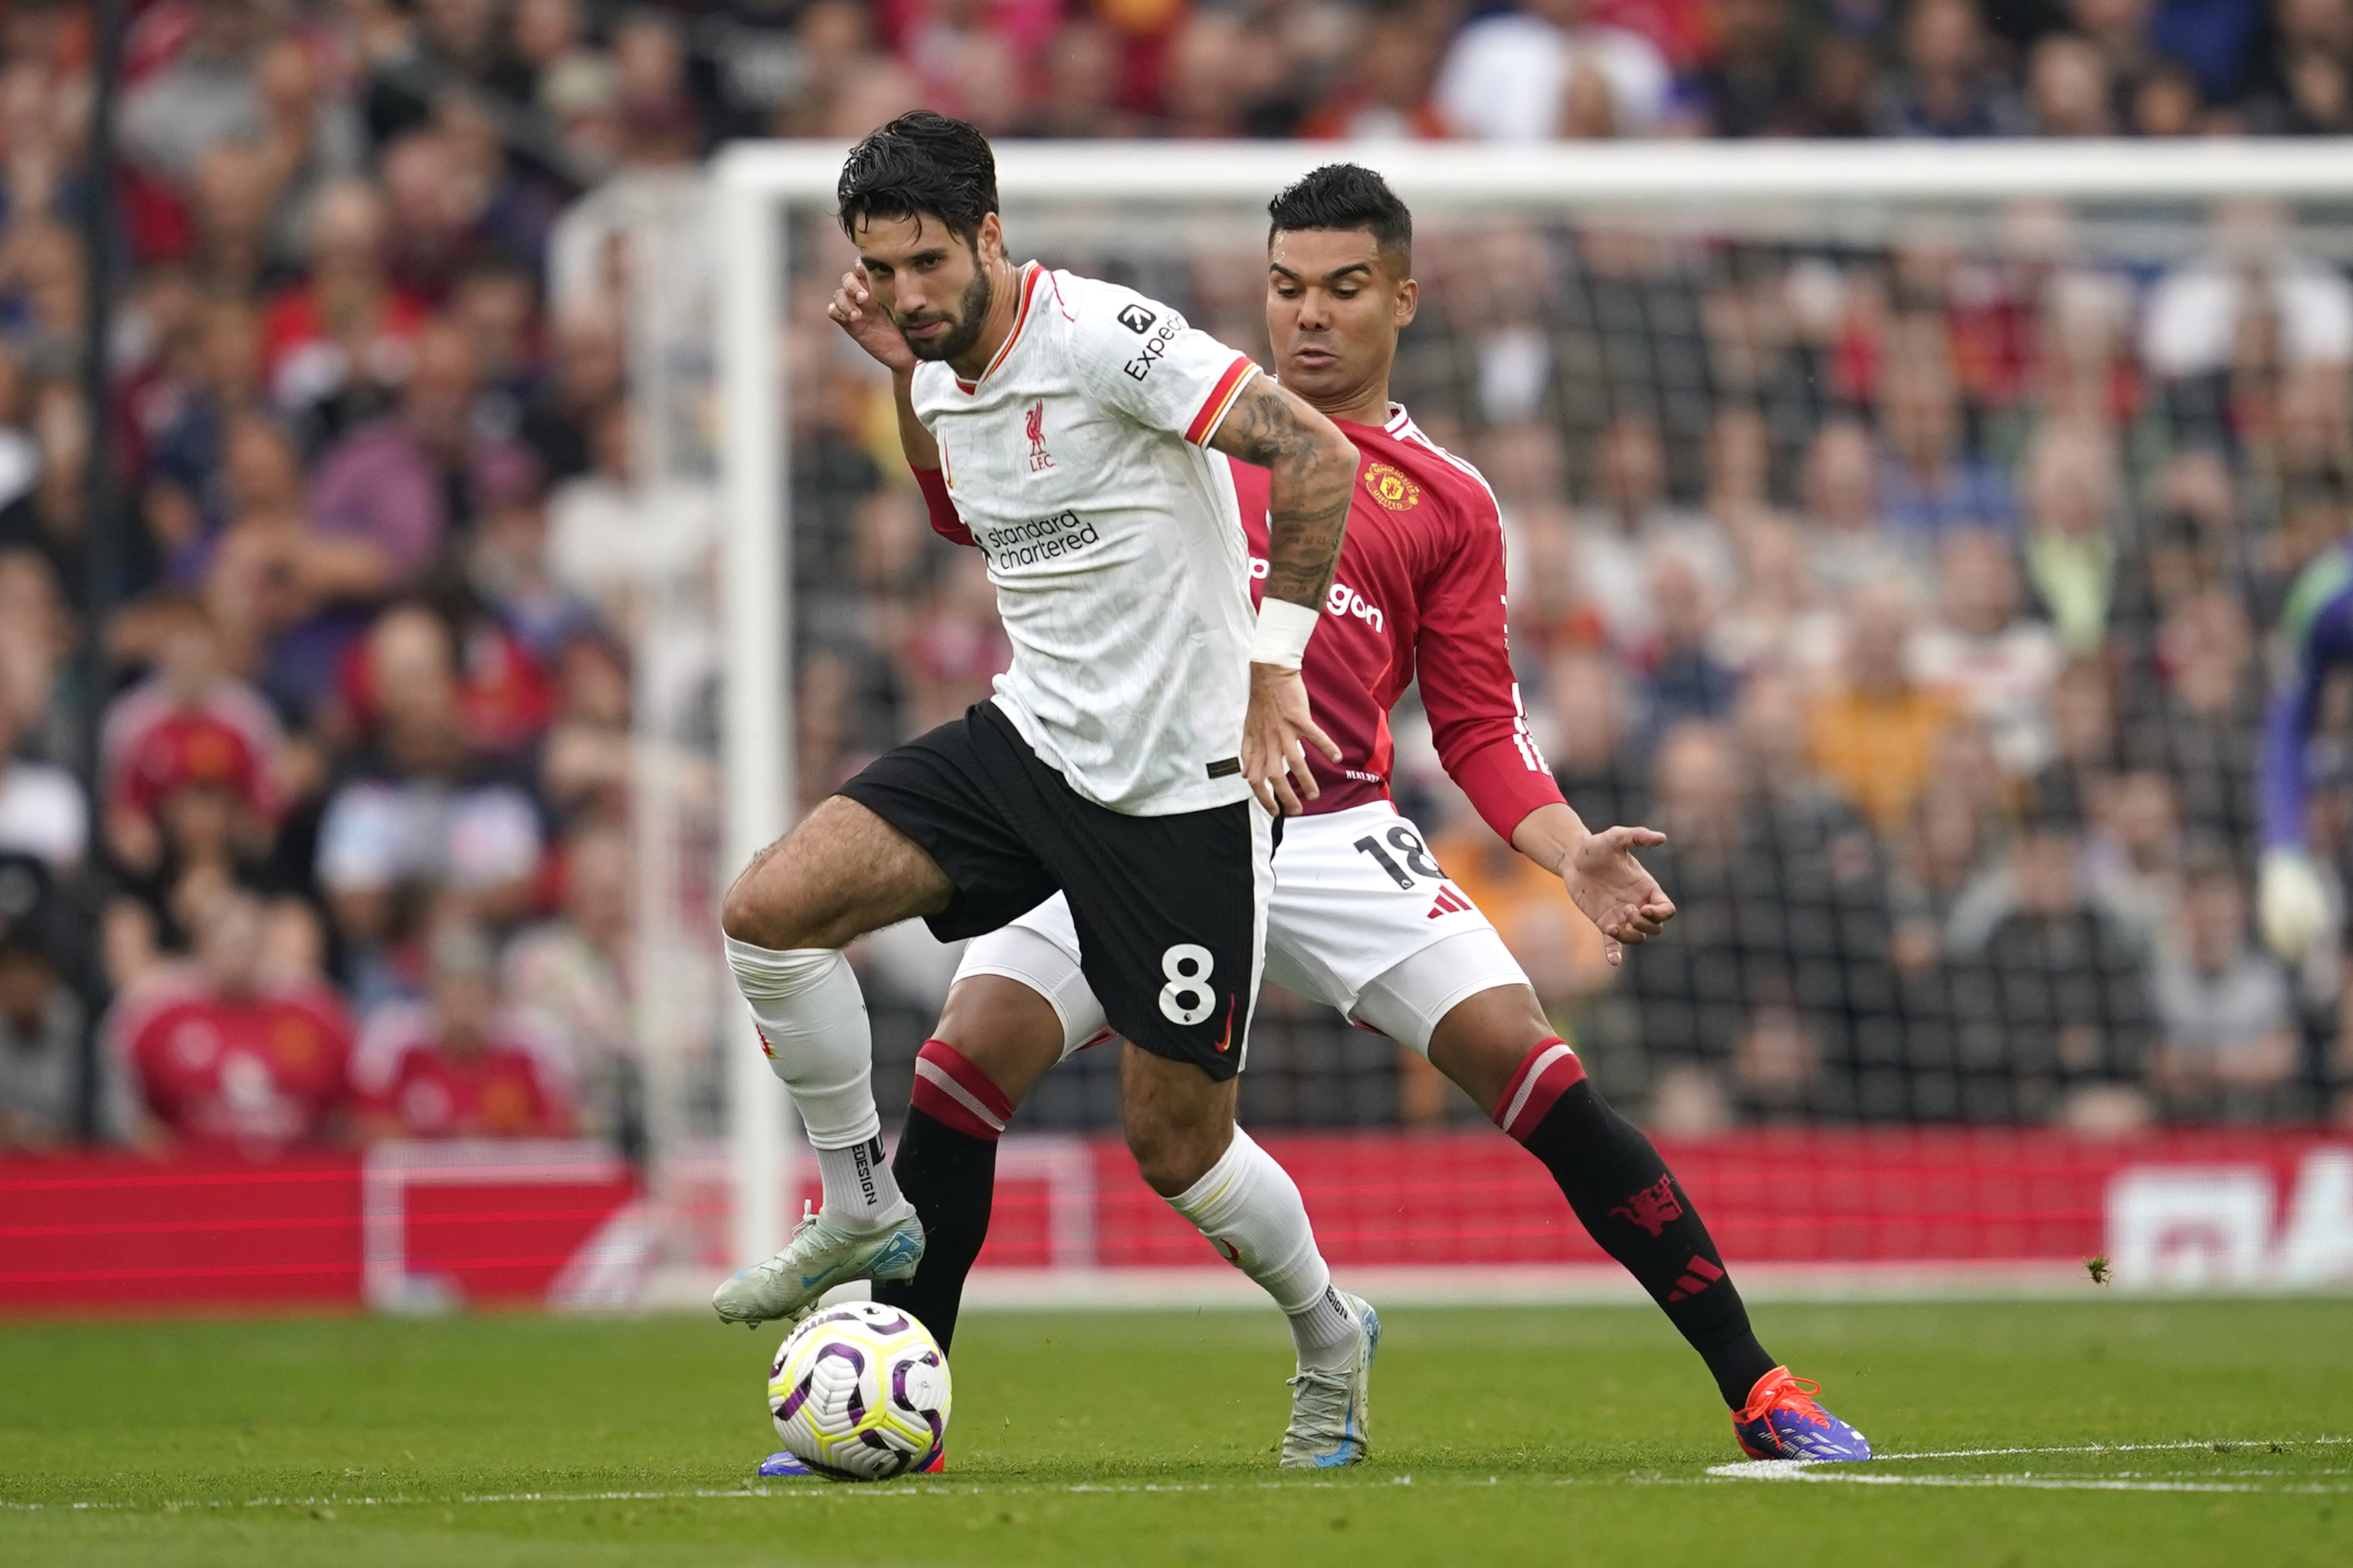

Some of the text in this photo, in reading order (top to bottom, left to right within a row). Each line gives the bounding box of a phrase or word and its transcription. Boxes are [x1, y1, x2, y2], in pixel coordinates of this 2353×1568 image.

[988, 509, 1080, 548] standard
[999, 522, 1099, 570] chartered
[1353, 827, 1450, 889] 18
[1158, 944, 1216, 1025] 8
